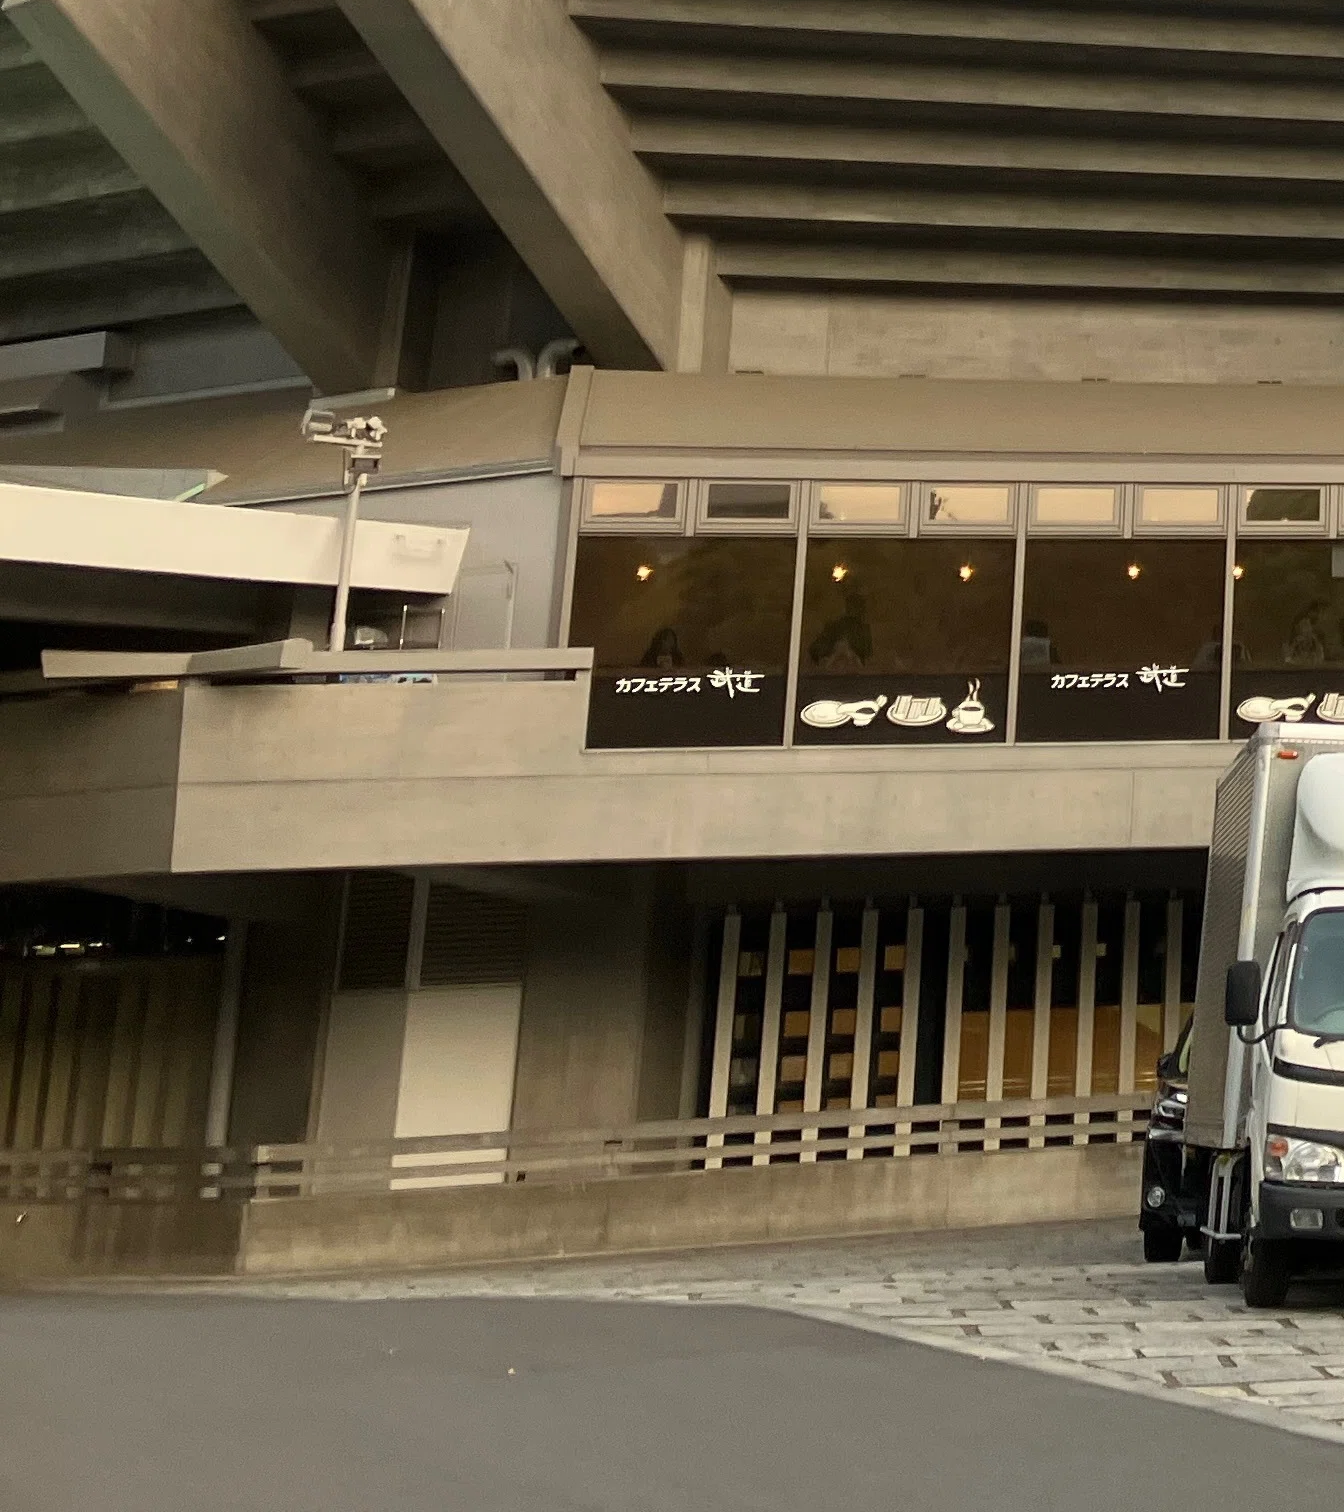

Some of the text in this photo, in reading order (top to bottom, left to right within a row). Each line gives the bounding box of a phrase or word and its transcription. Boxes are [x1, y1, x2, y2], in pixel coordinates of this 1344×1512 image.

[615, 677, 701, 693] カフェテラス
[1050, 673, 1129, 689] カフェテラス
